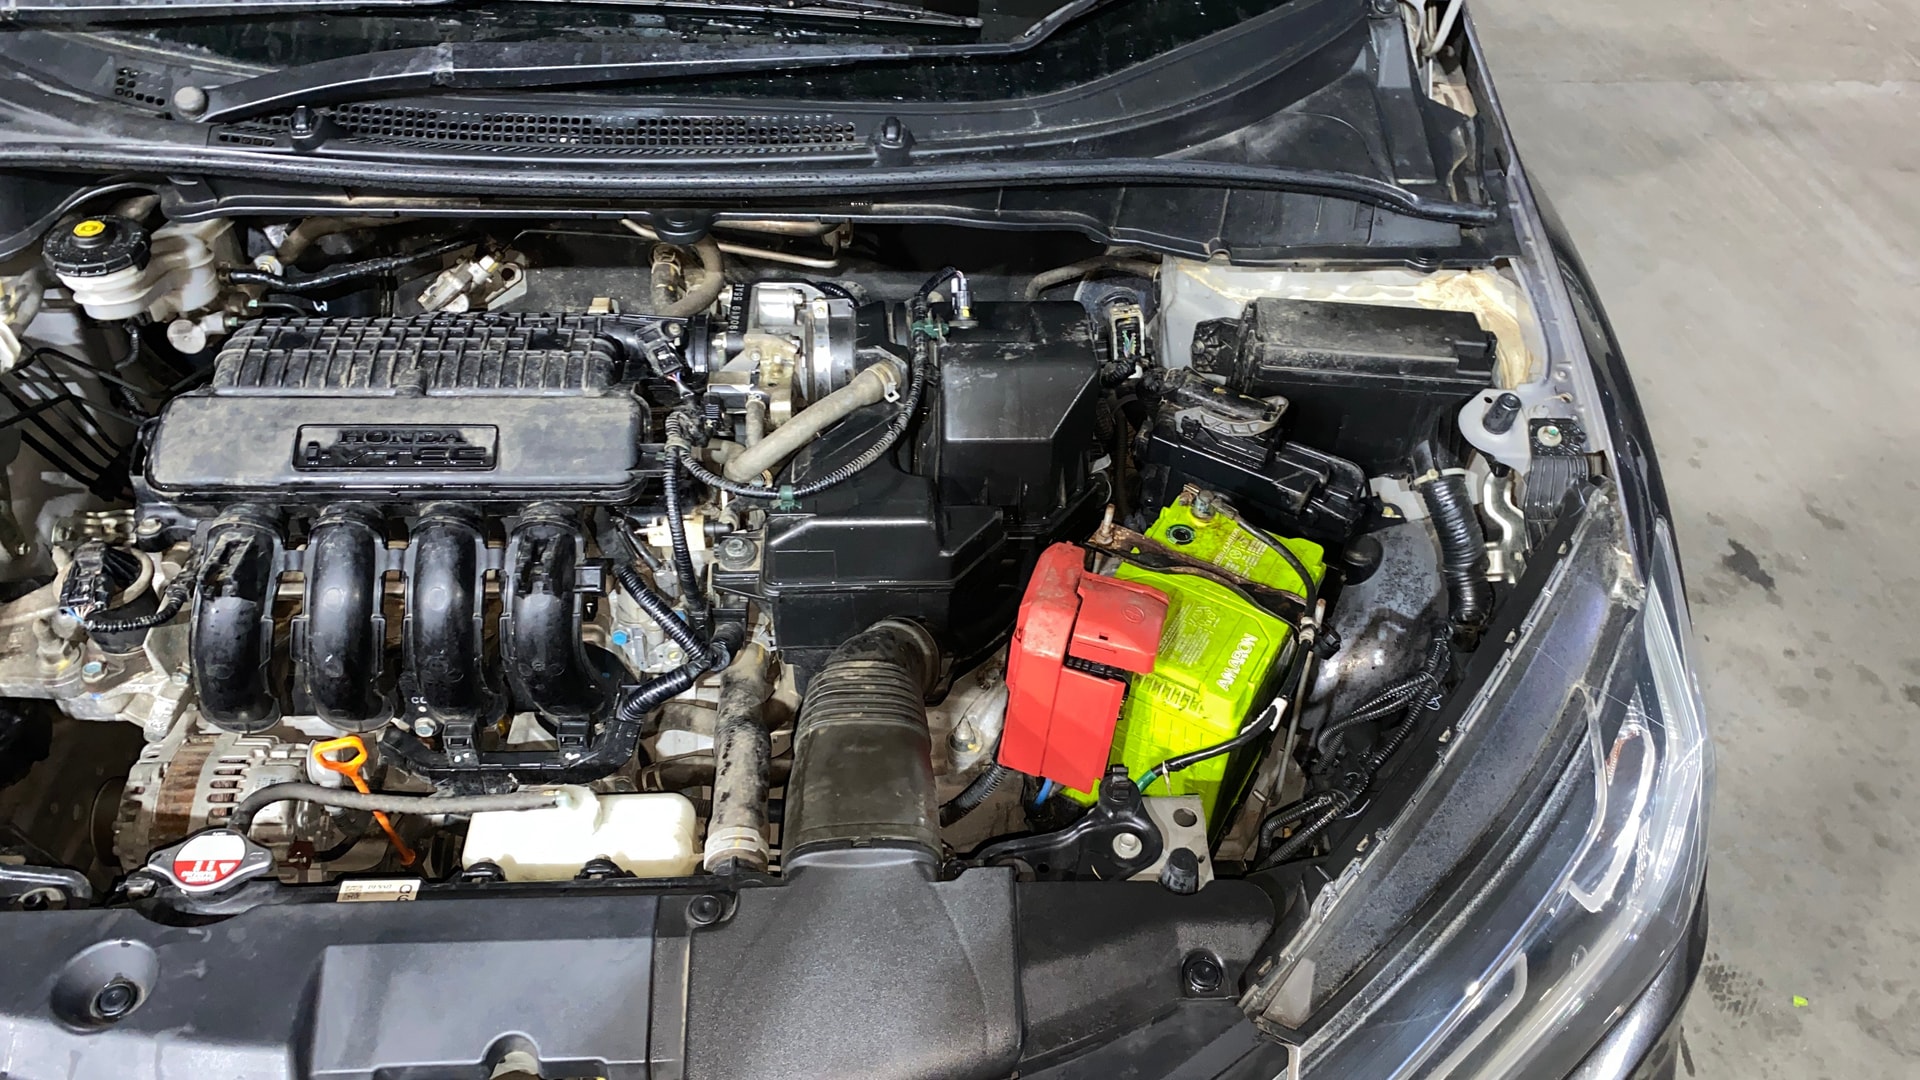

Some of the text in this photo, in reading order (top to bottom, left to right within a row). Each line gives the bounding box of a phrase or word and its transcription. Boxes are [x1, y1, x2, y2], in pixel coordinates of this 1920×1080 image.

[337, 429, 469, 446] HONDA
[1215, 632, 1260, 692] AMARON
[399, 884, 413, 894] Q
